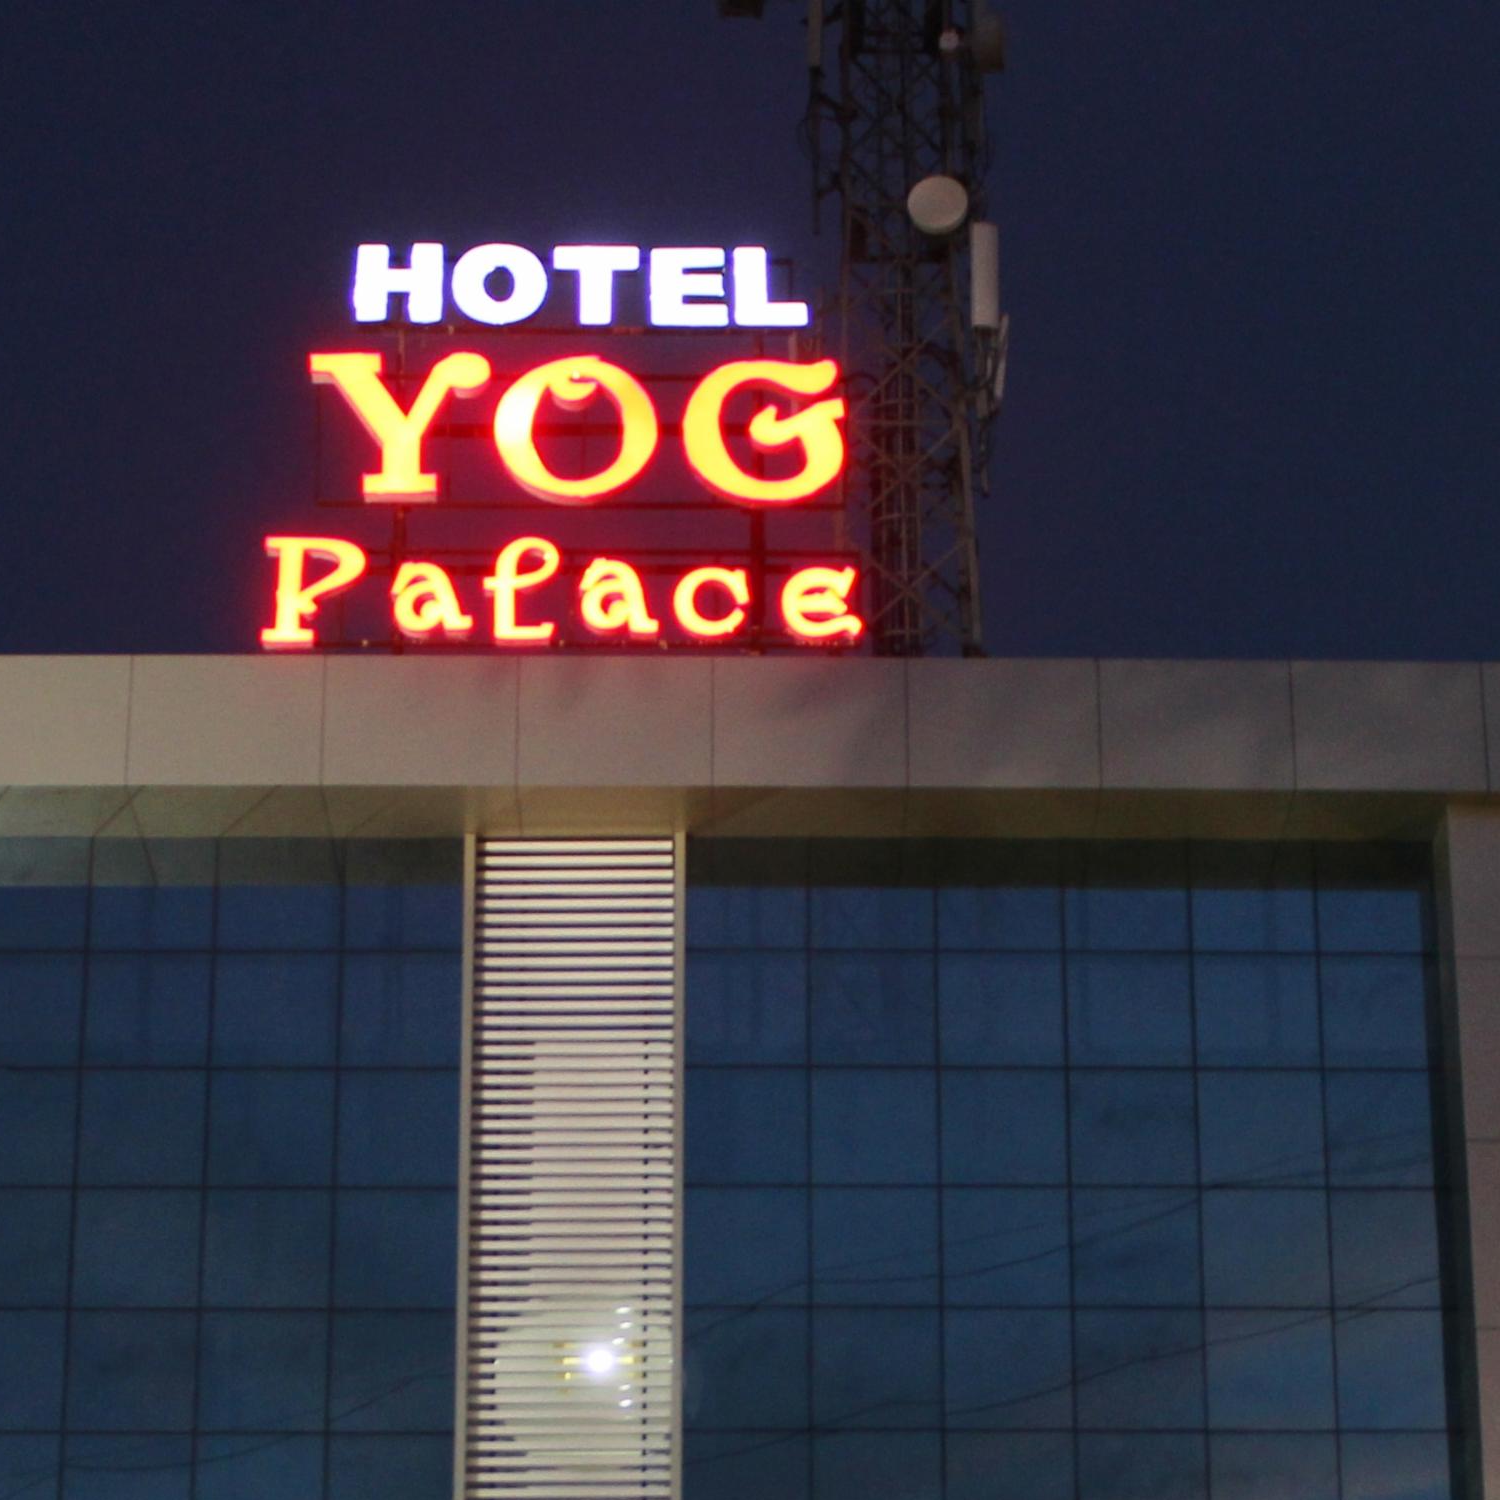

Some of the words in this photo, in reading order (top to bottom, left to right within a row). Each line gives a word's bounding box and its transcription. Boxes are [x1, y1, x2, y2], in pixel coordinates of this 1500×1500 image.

[352, 241, 810, 327] HOTEL
[308, 351, 846, 504] YOG
[260, 535, 864, 650] Palace
